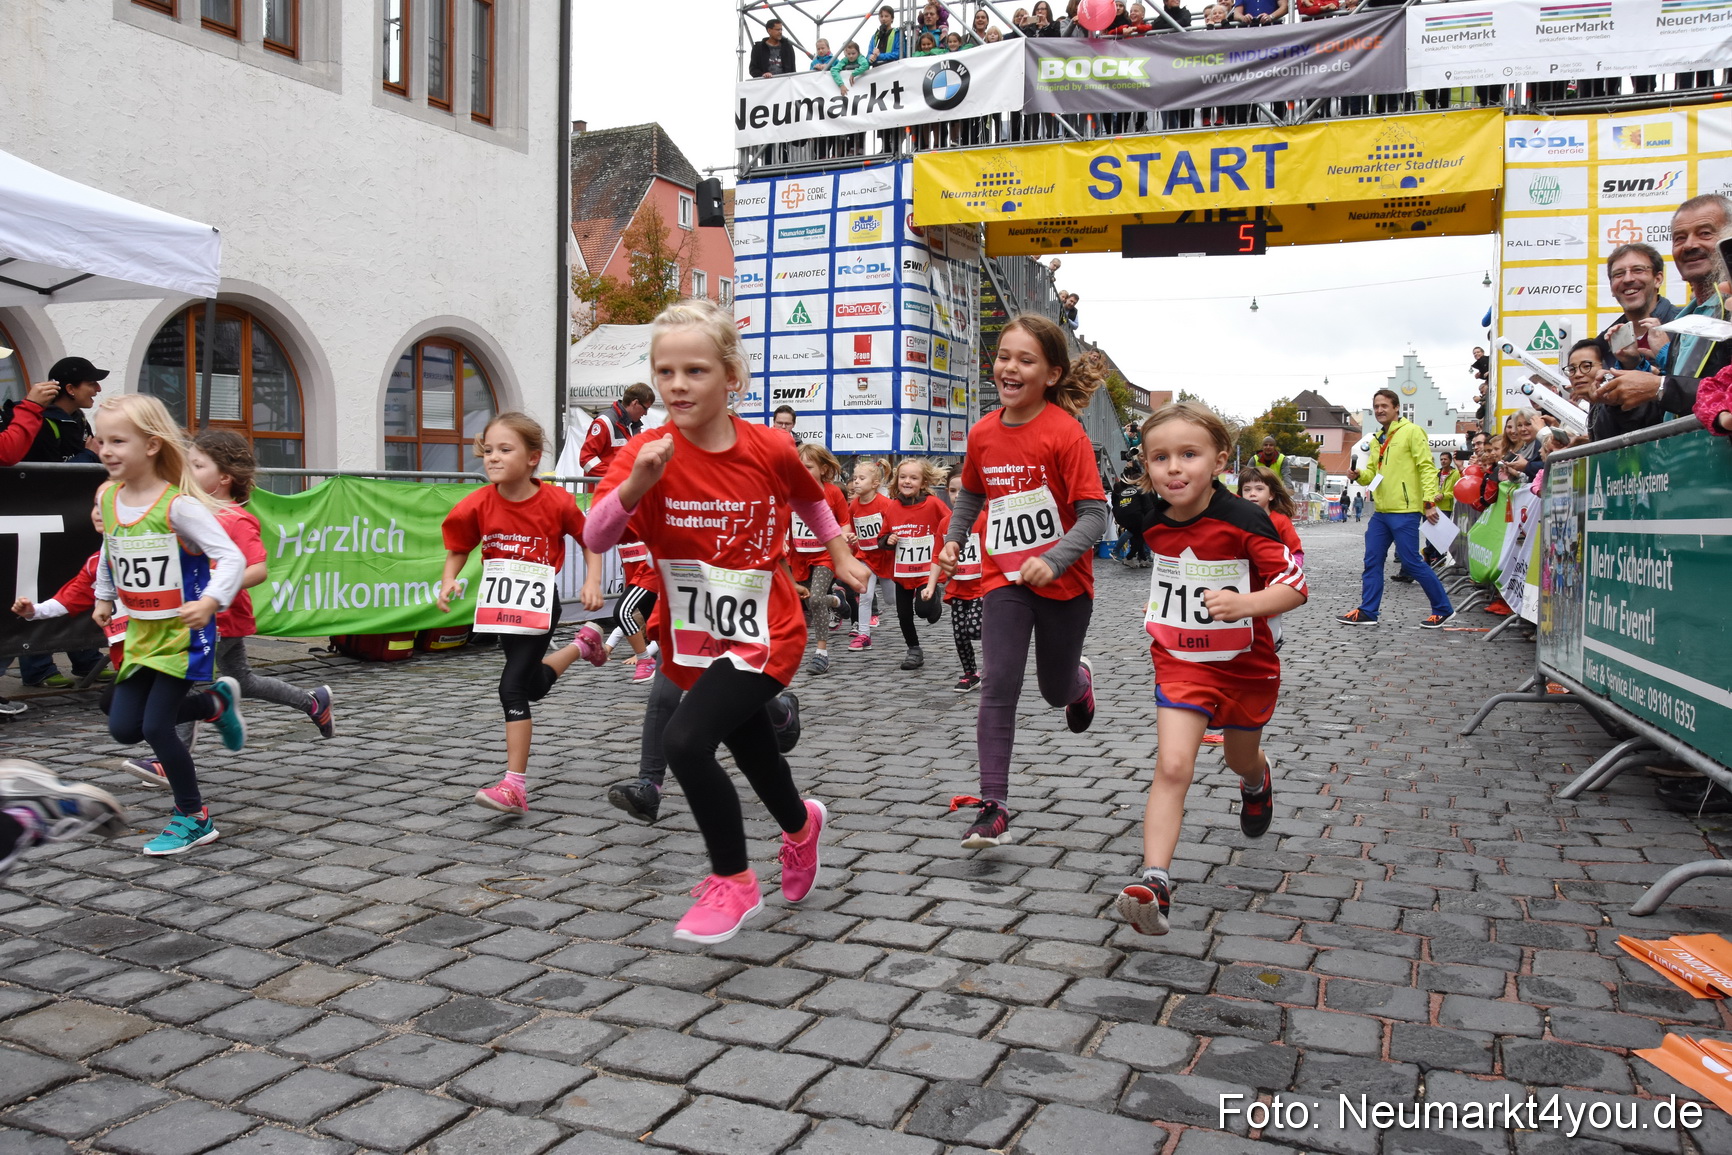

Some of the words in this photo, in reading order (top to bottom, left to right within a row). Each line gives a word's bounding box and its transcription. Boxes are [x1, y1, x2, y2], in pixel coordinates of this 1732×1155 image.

[1536, 20, 1614, 35] NeuerMarkt
[1421, 28, 1496, 45] NeuerMarkt
[1172, 52, 1225, 69] OFFICE
[1229, 44, 1311, 63] INDUSTRY
[1315, 36, 1384, 54] LOUNGE
[1039, 57, 1149, 81] BOCK
[1200, 59, 1351, 85] www.bockonline.de
[735, 81, 905, 131] Neumarkt
[1646, 139, 1670, 147] KANN
[1088, 142, 1288, 200] START
[1327, 161, 1402, 175] Neumarkter
[1404, 156, 1465, 171] Stadtlauf
[807, 186, 825, 195] CODE
[941, 186, 1004, 199] Neumarkter
[1006, 183, 1056, 196] Stadtlauf
[1602, 178, 1655, 193] swn
[807, 193, 828, 201] CLINIC
[1601, 191, 1636, 199] stadtwerke
[1637, 190, 1669, 198] neumarkt
[1348, 209, 1412, 221] Neumarkter
[1415, 203, 1467, 218] Stadtlauf
[1008, 226, 1062, 237] Neumarkter
[1064, 224, 1108, 235] Stadtlauf
[1238, 224, 1255, 252] 5
[788, 269, 826, 280] VARIOTEC
[866, 272, 891, 280] energie
[1527, 285, 1583, 295] VARIOTEC
[772, 388, 806, 399] swn
[843, 399, 882, 407] Lammsbräu
[1606, 471, 1669, 497] Event-Leit-Systeme
[665, 497, 746, 512] Neumarkter
[1008, 490, 1049, 509] BOCK
[665, 514, 728, 531] Stadtlauf
[992, 508, 1055, 550] 7409
[123, 538, 168, 550] BOCK
[276, 515, 405, 558] Herzlich
[899, 545, 931, 562] 7171
[510, 563, 549, 576] BOCK
[1185, 563, 1239, 577] BOCK
[1590, 544, 1615, 580] Mehr
[1617, 545, 1673, 591] Sicherheit
[709, 567, 765, 589] BOCK
[485, 576, 546, 608] 7073
[496, 611, 522, 624] Anna
[677, 586, 760, 638] 7408
[1588, 590, 1602, 626] für
[1603, 594, 1618, 632] Ihr
[1619, 599, 1655, 645] Event!
[1178, 633, 1210, 648] Leni
[1586, 657, 1599, 683] Miet
[1599, 664, 1605, 686] &
[1606, 666, 1628, 698] Service
[1628, 677, 1646, 707] Line:
[1647, 686, 1672, 720] 09181
[1674, 698, 1696, 733] 6352
